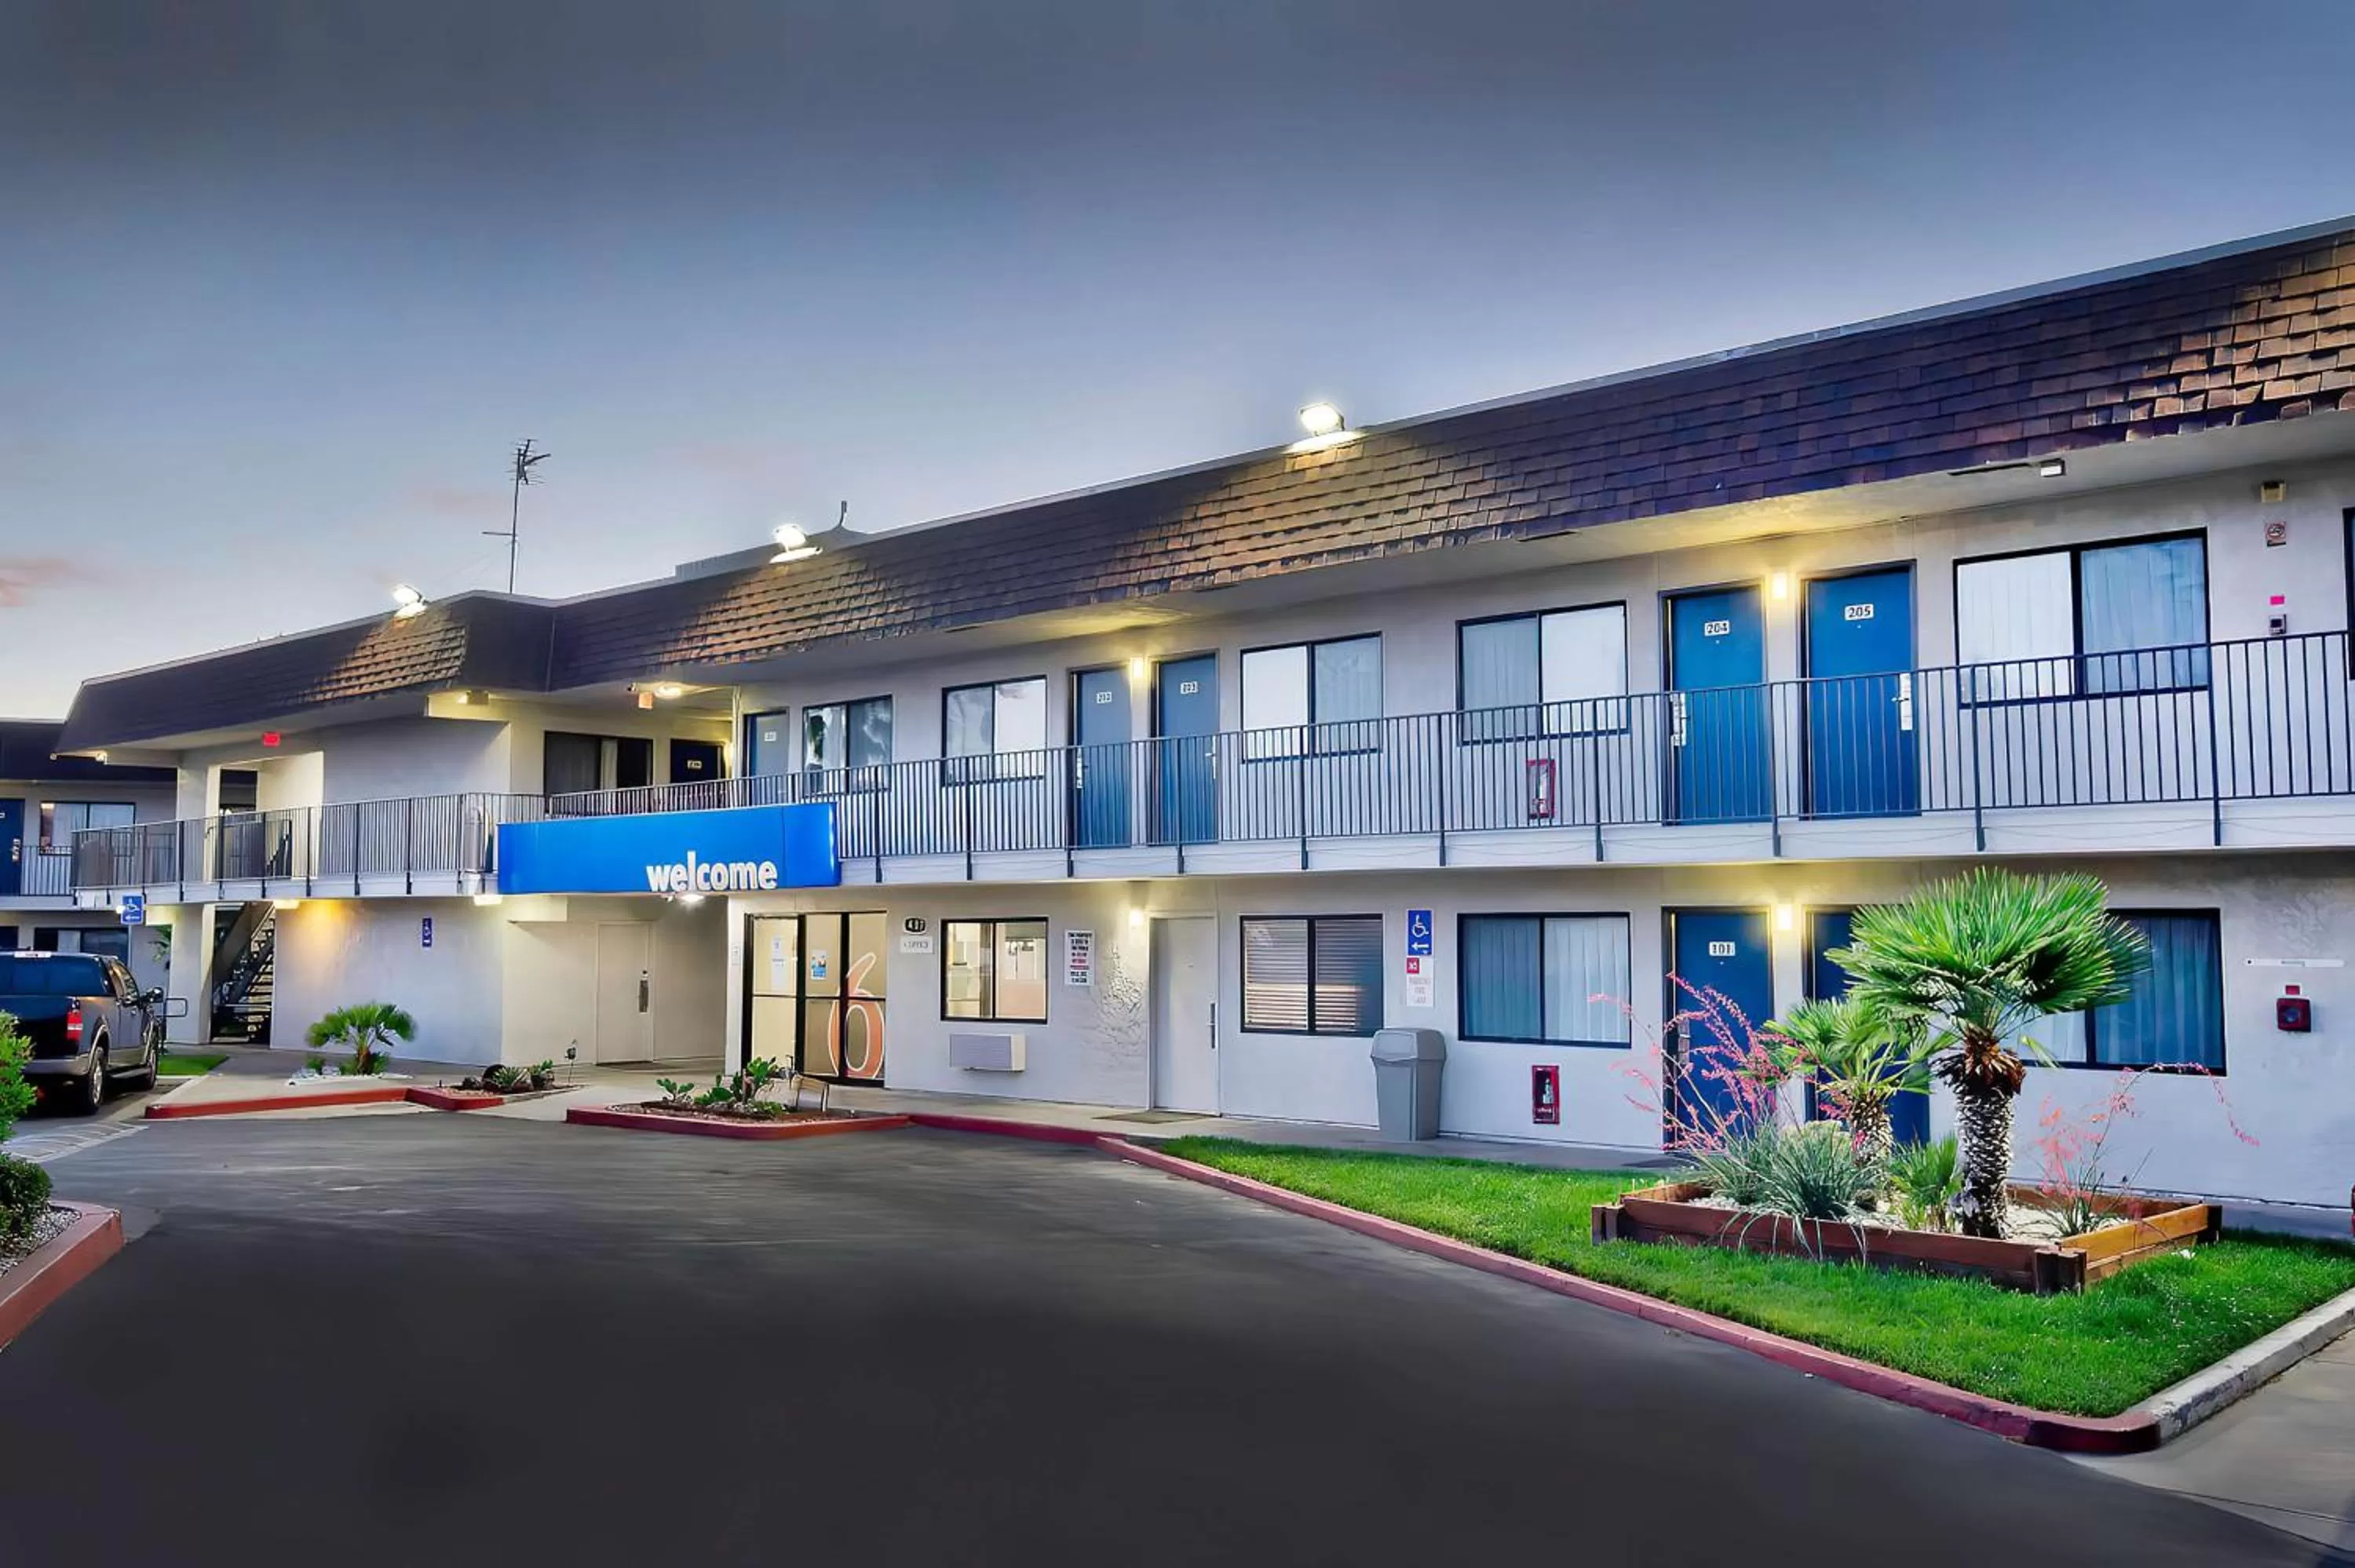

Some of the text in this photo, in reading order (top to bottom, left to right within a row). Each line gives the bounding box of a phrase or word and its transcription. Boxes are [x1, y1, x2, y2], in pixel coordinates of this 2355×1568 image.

[1848, 606, 1871, 618] 205
[1707, 622, 1728, 633] 204
[645, 850, 778, 892] welcome
[1711, 943, 1733, 954] 101
[828, 952, 885, 1079] 6
